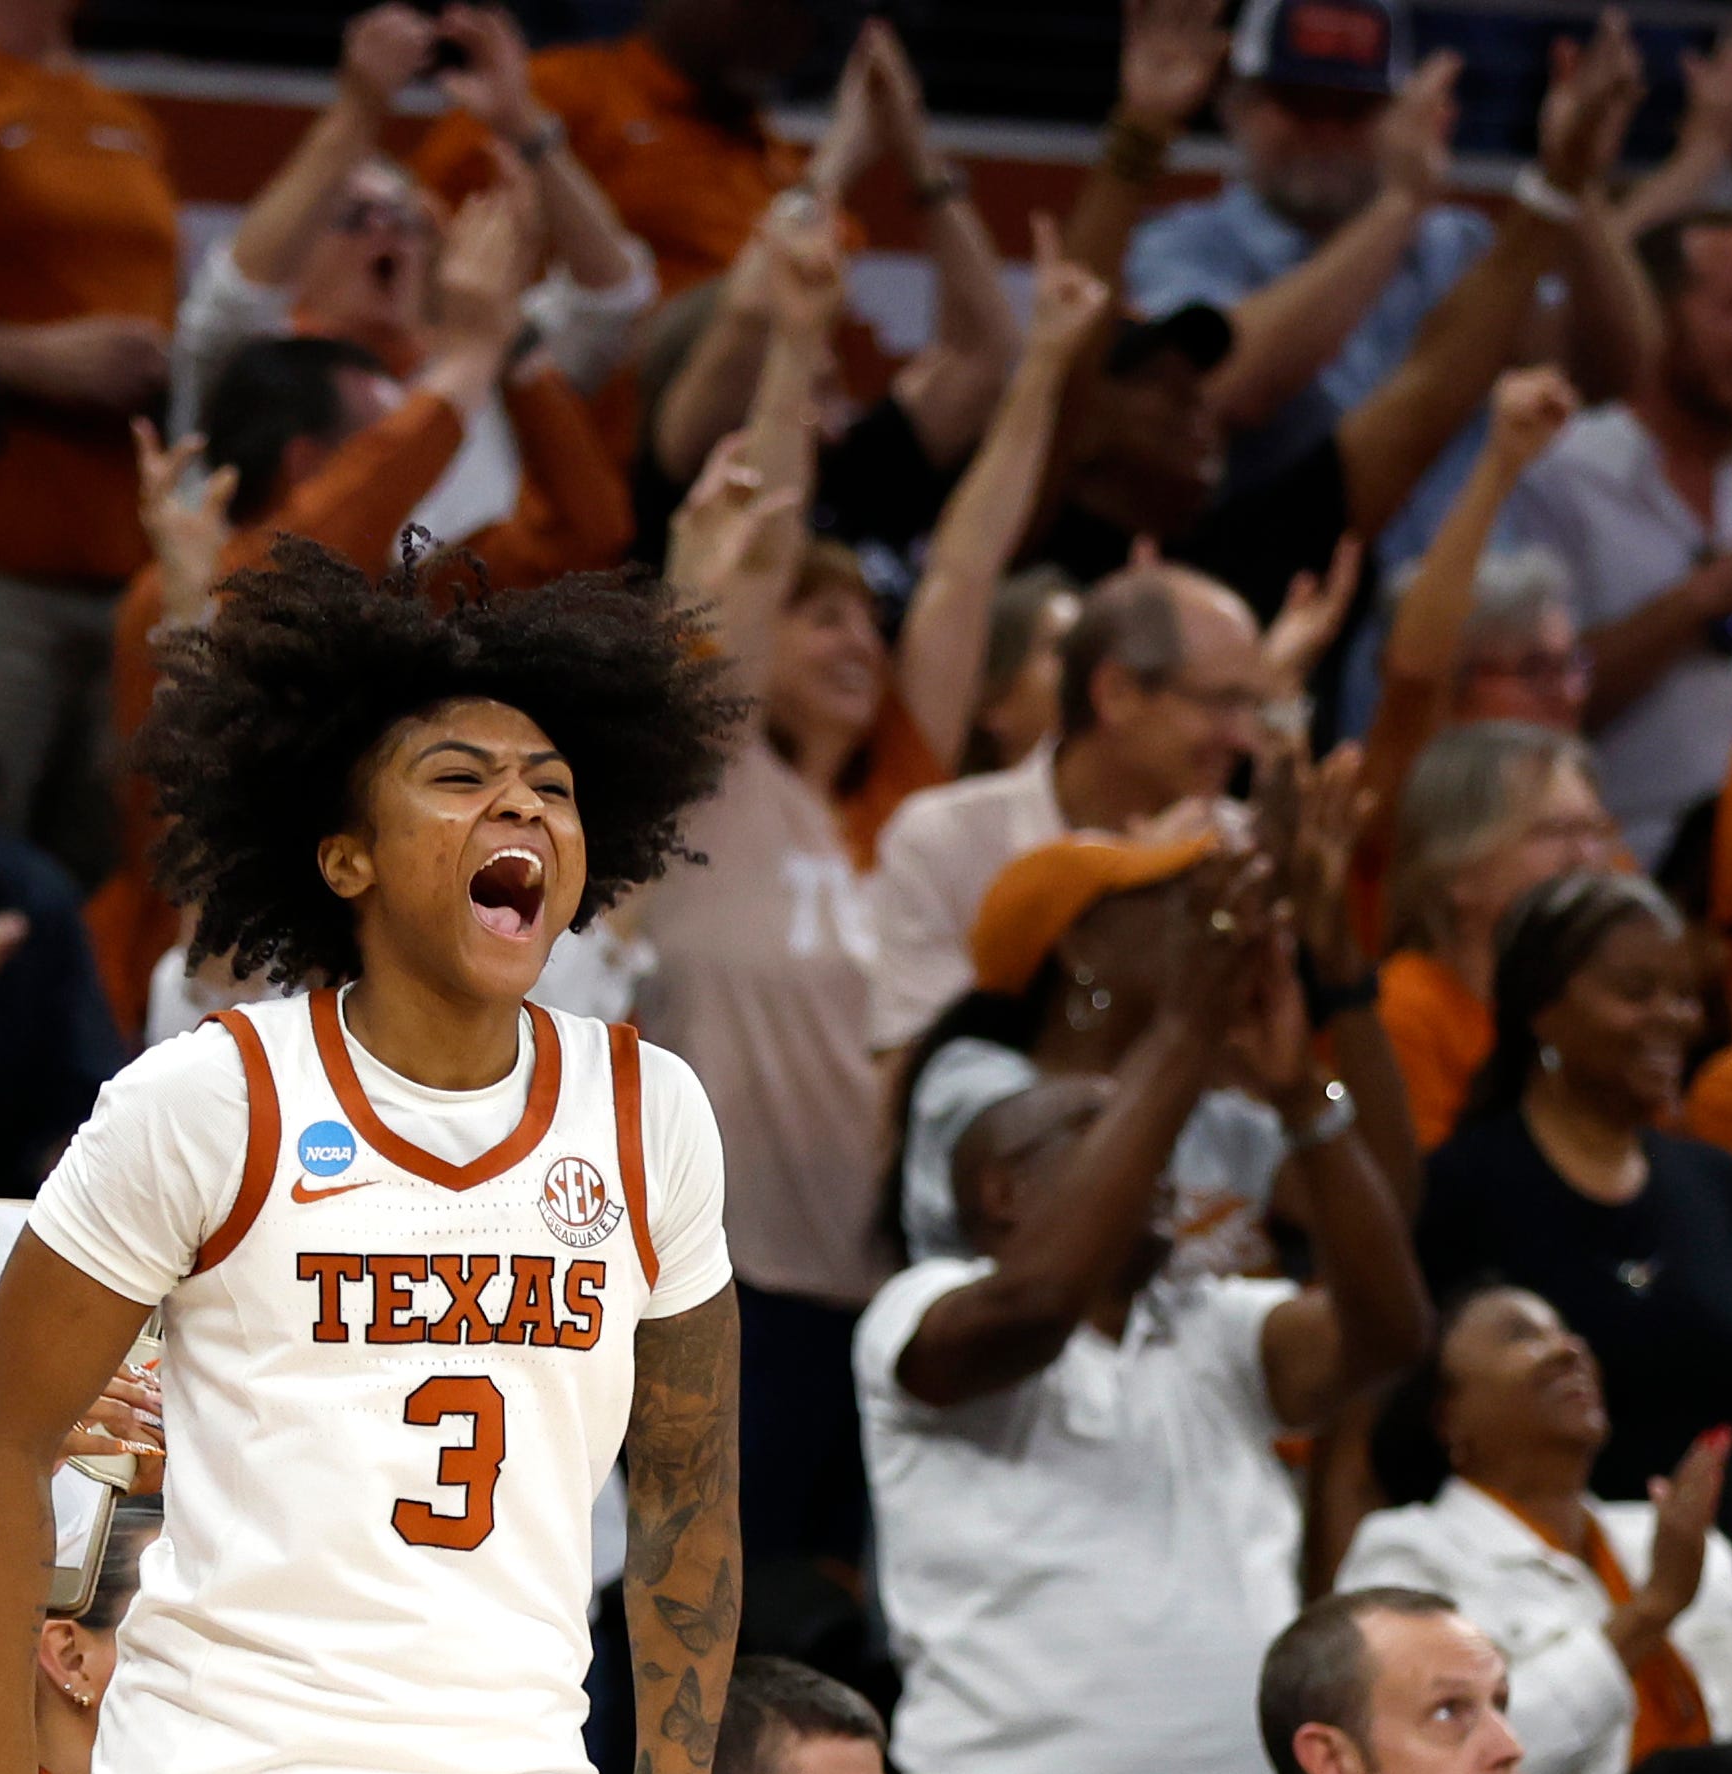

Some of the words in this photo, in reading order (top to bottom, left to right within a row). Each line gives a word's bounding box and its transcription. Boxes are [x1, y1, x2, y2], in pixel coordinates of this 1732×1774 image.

[305, 1146, 352, 1162] NCAA
[547, 1160, 603, 1223] SEC
[547, 1216, 612, 1246] GRADUATE
[296, 1252, 607, 1351] TEXAS
[390, 1375, 506, 1552] 3
